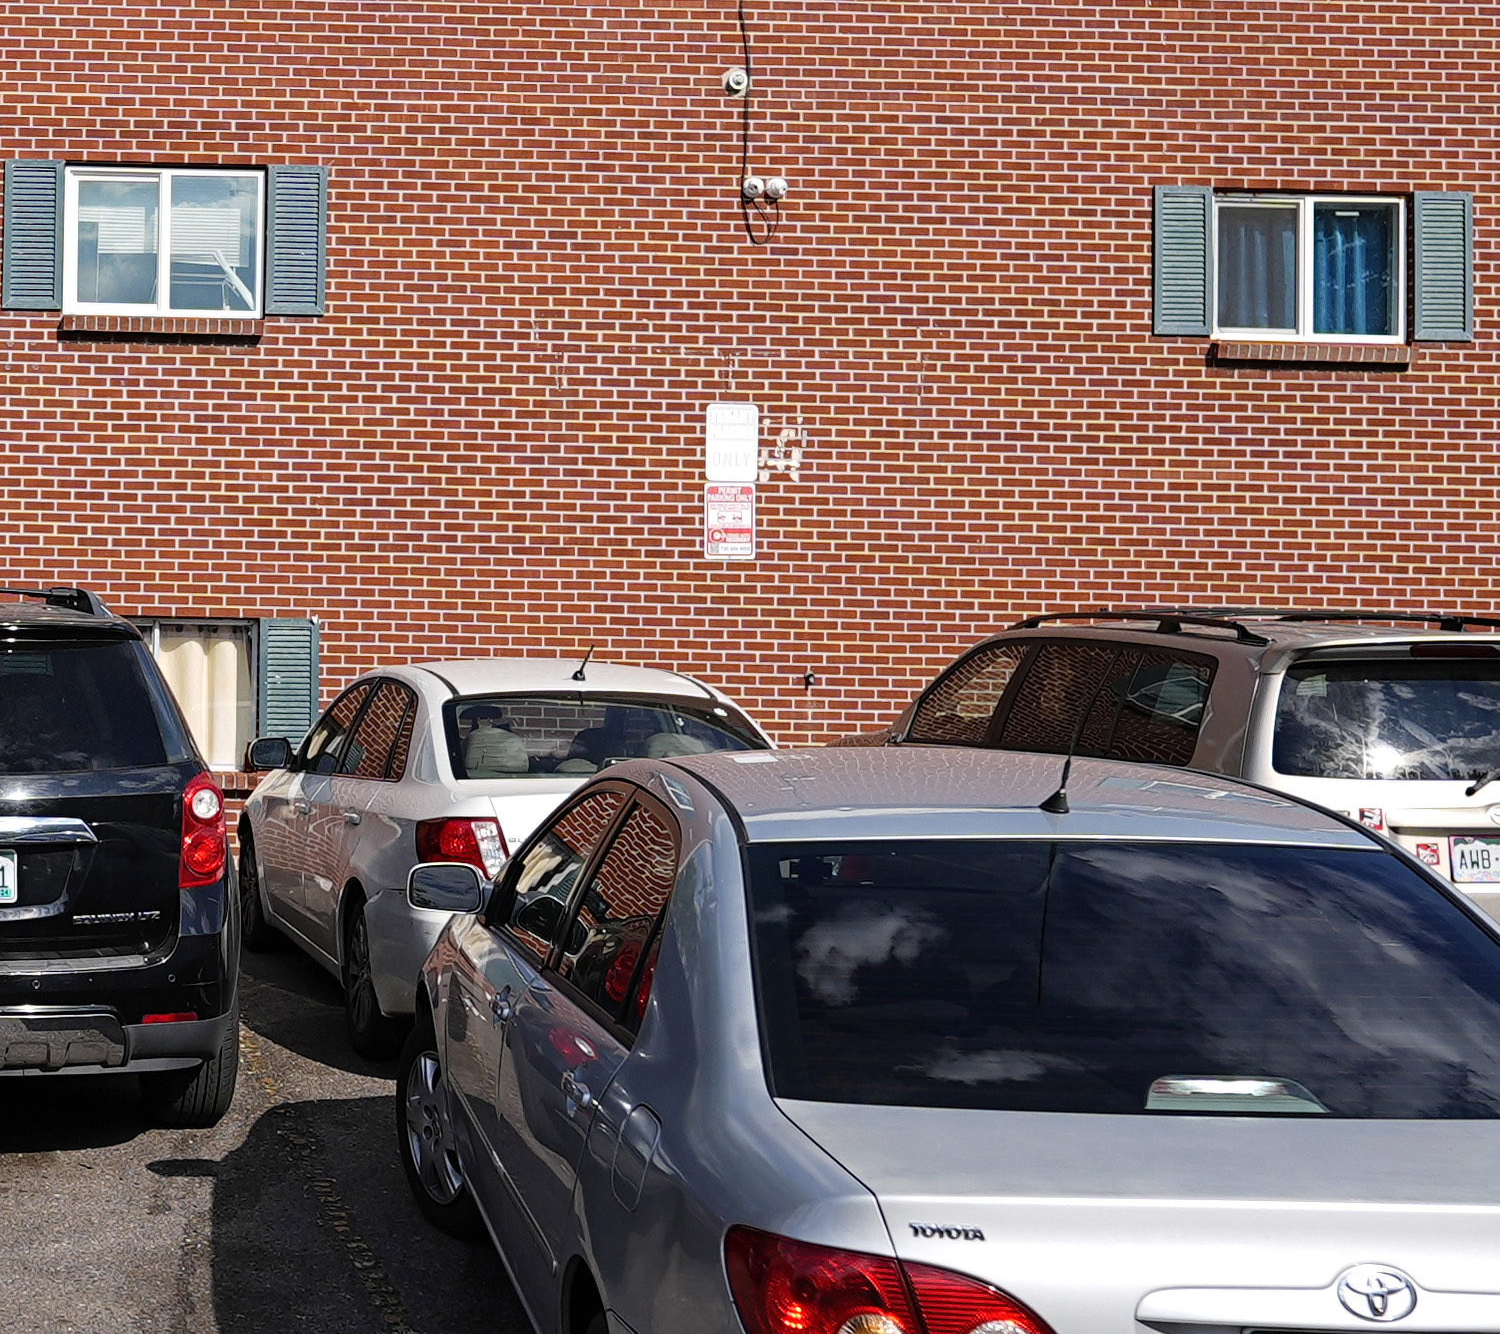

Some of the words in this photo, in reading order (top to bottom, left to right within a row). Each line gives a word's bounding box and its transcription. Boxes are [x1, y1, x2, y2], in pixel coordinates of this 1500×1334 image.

[713, 451, 751, 467] ONLY
[137, 910, 161, 922] LTZ
[908, 1223, 986, 1241] TOYOTA
